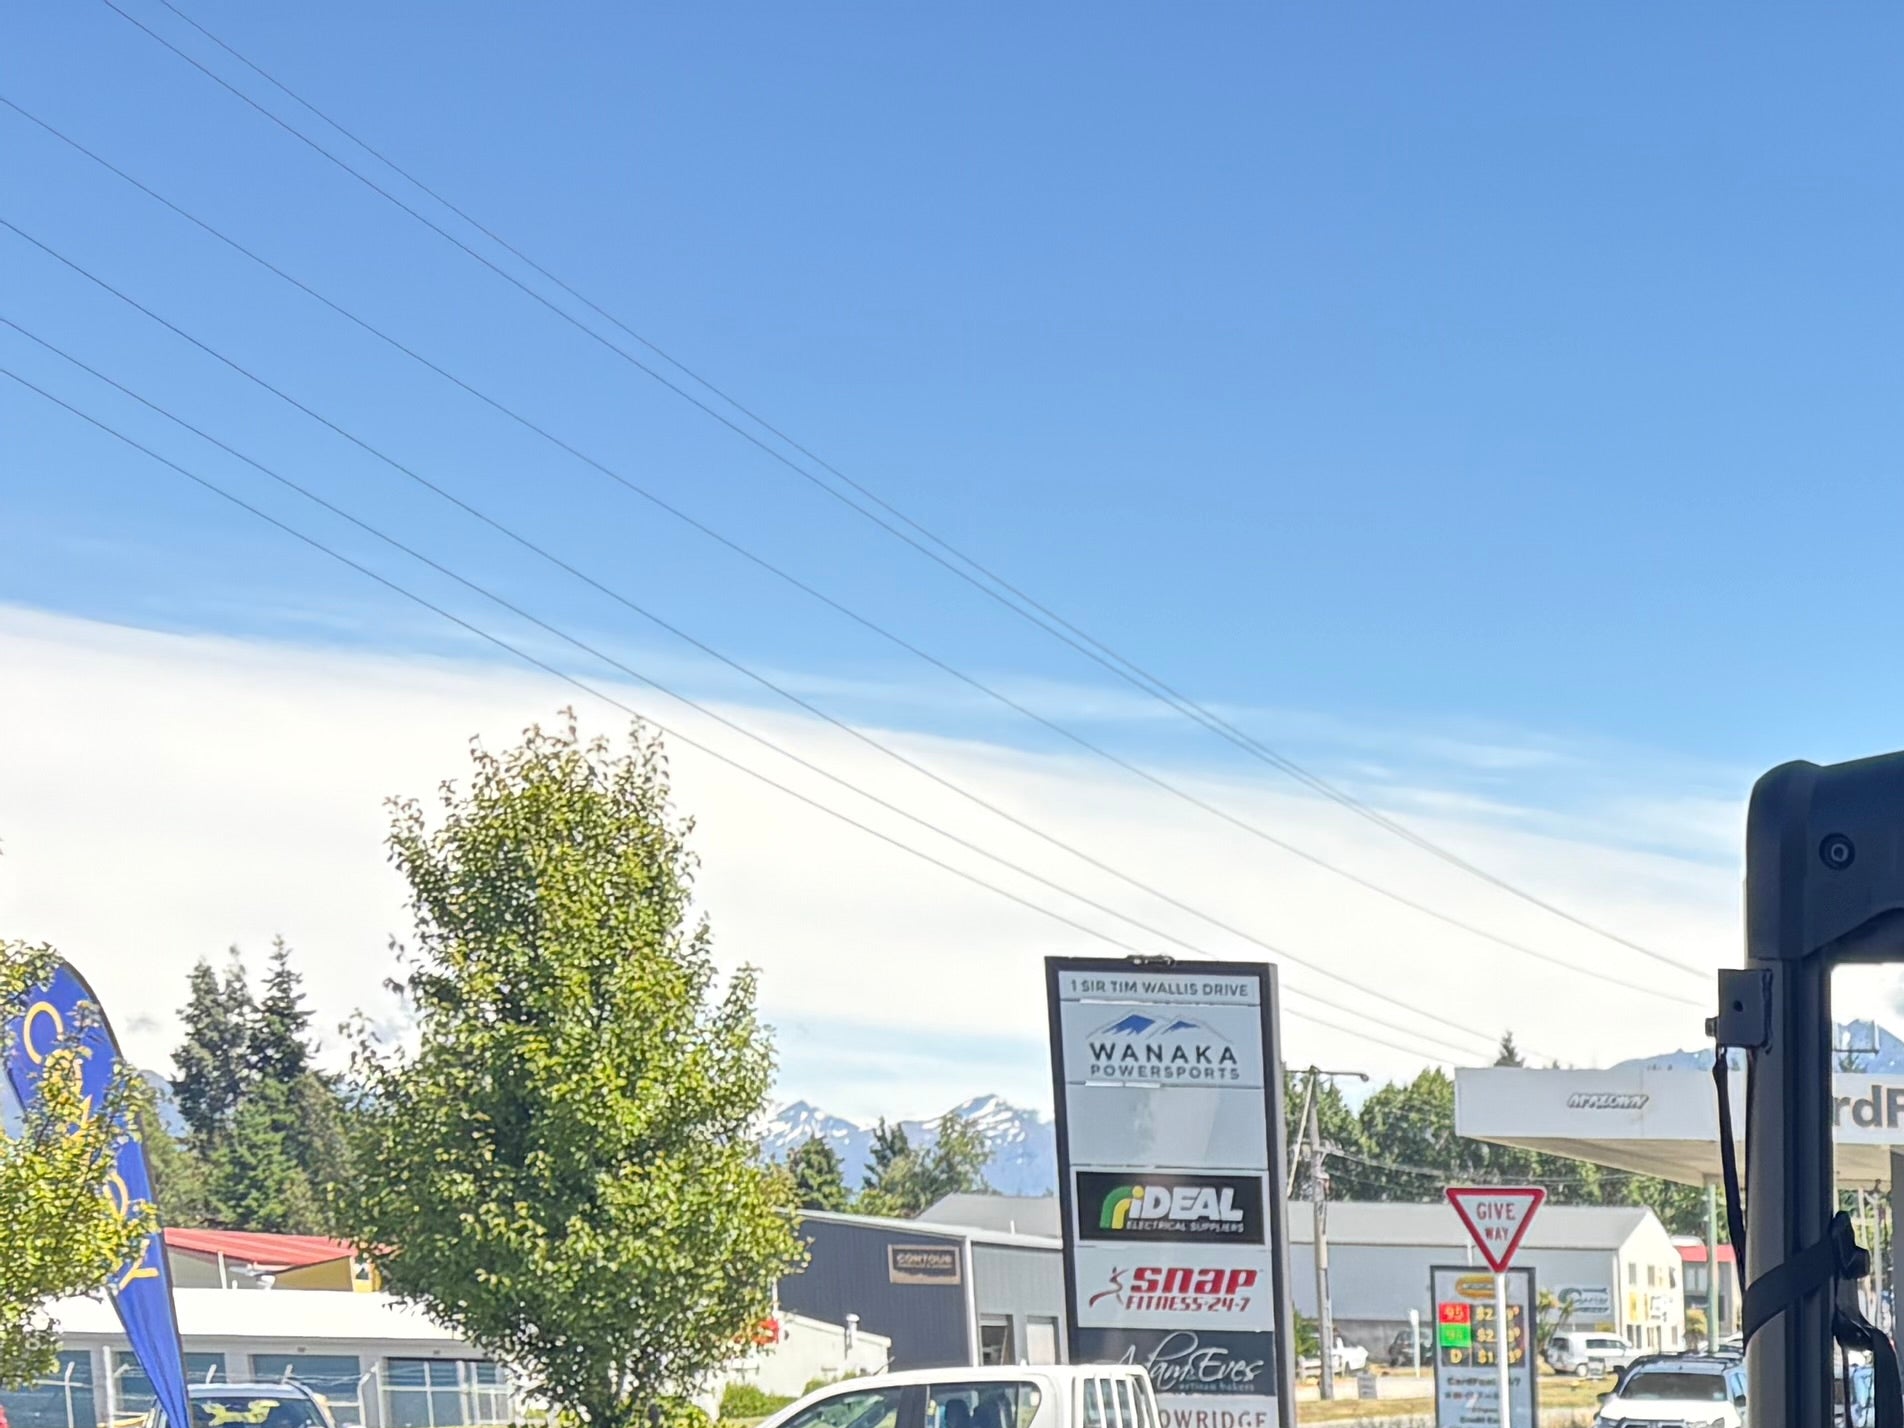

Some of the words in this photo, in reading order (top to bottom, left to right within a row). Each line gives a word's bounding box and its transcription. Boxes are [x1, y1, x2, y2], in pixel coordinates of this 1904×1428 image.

[1071, 980, 1077, 993] 1
[1082, 980, 1106, 993] SIR
[1110, 981, 1138, 993] TIM
[1143, 982, 1198, 996] WALLIS
[1203, 983, 1249, 996] DRIVE
[1089, 1042, 1238, 1065] WANAKA
[1090, 1064, 1240, 1080] POWERSPORTS
[1475, 1202, 1516, 1221] GIVE
[1126, 1219, 1186, 1232] ELECTRICAL
[1189, 1221, 1245, 1233] SUPPLIERS
[1484, 1227, 1509, 1242] WAY
